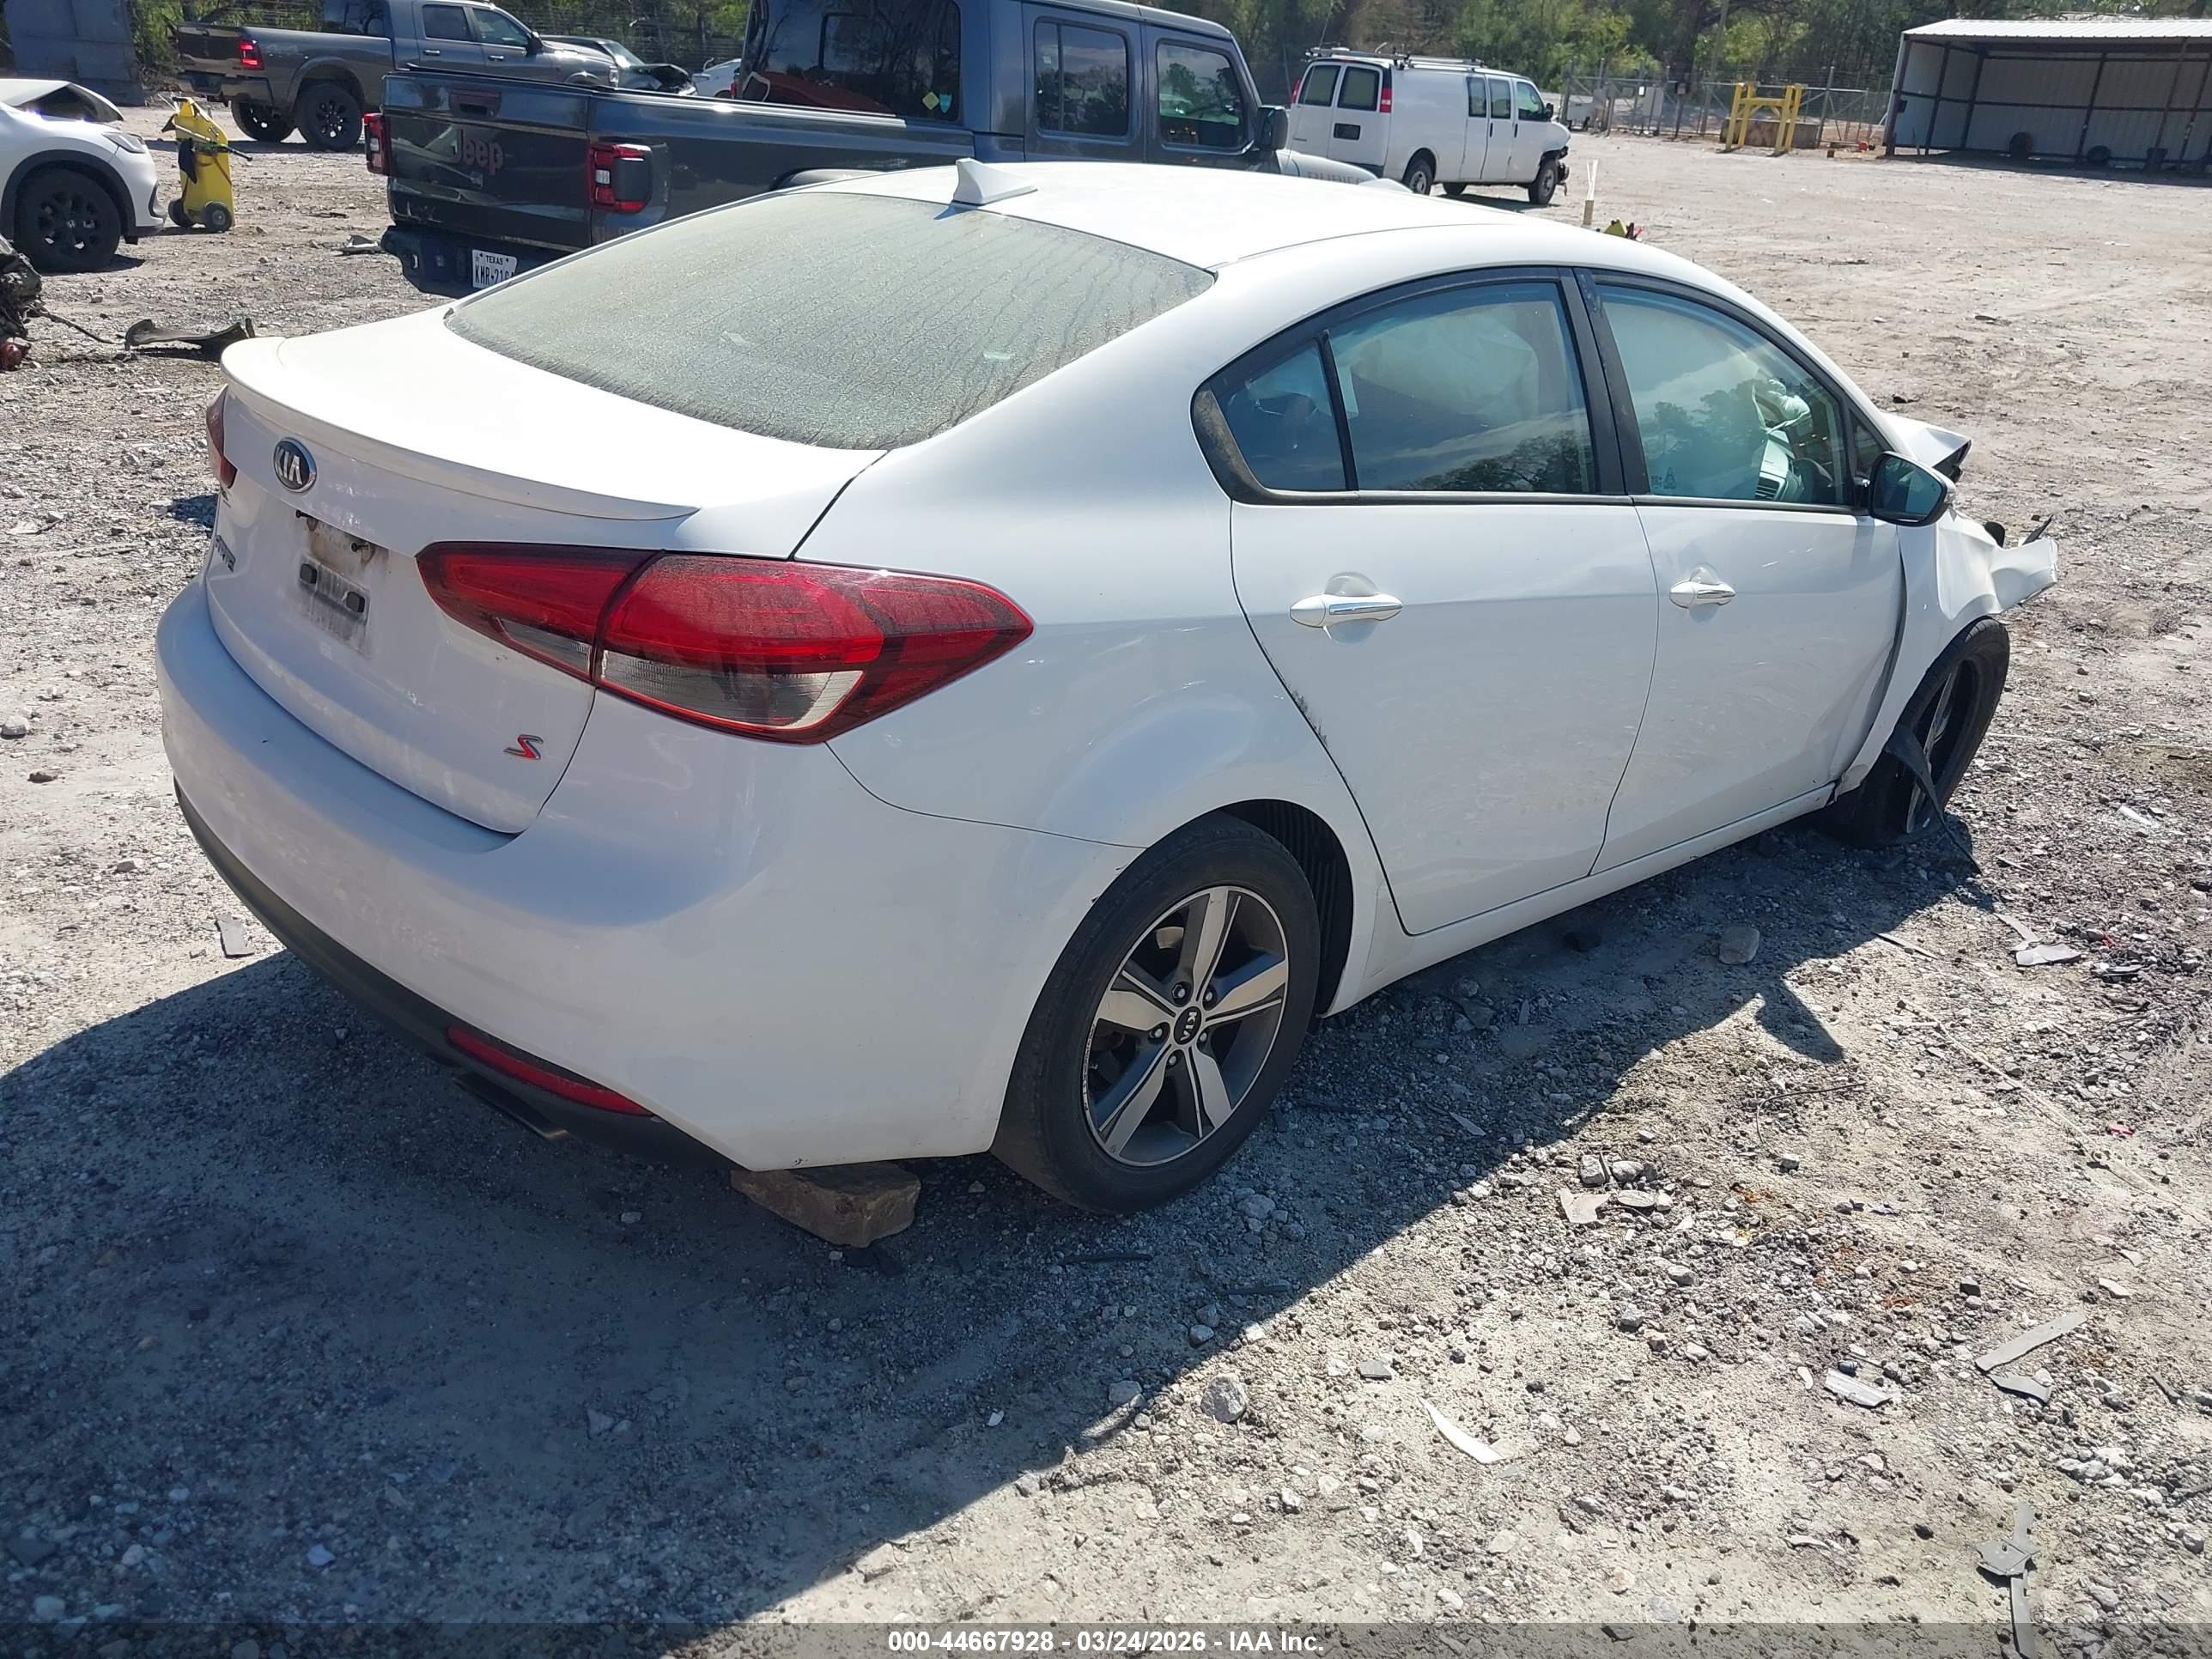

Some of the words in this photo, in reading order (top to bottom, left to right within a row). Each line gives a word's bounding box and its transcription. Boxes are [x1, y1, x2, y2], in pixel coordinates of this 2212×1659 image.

[453, 127, 504, 176] Jeep
[485, 255, 503, 265] TEXAS
[275, 446, 303, 486] KIA
[502, 733, 544, 761] S
[1180, 1012, 1198, 1042] KIA
